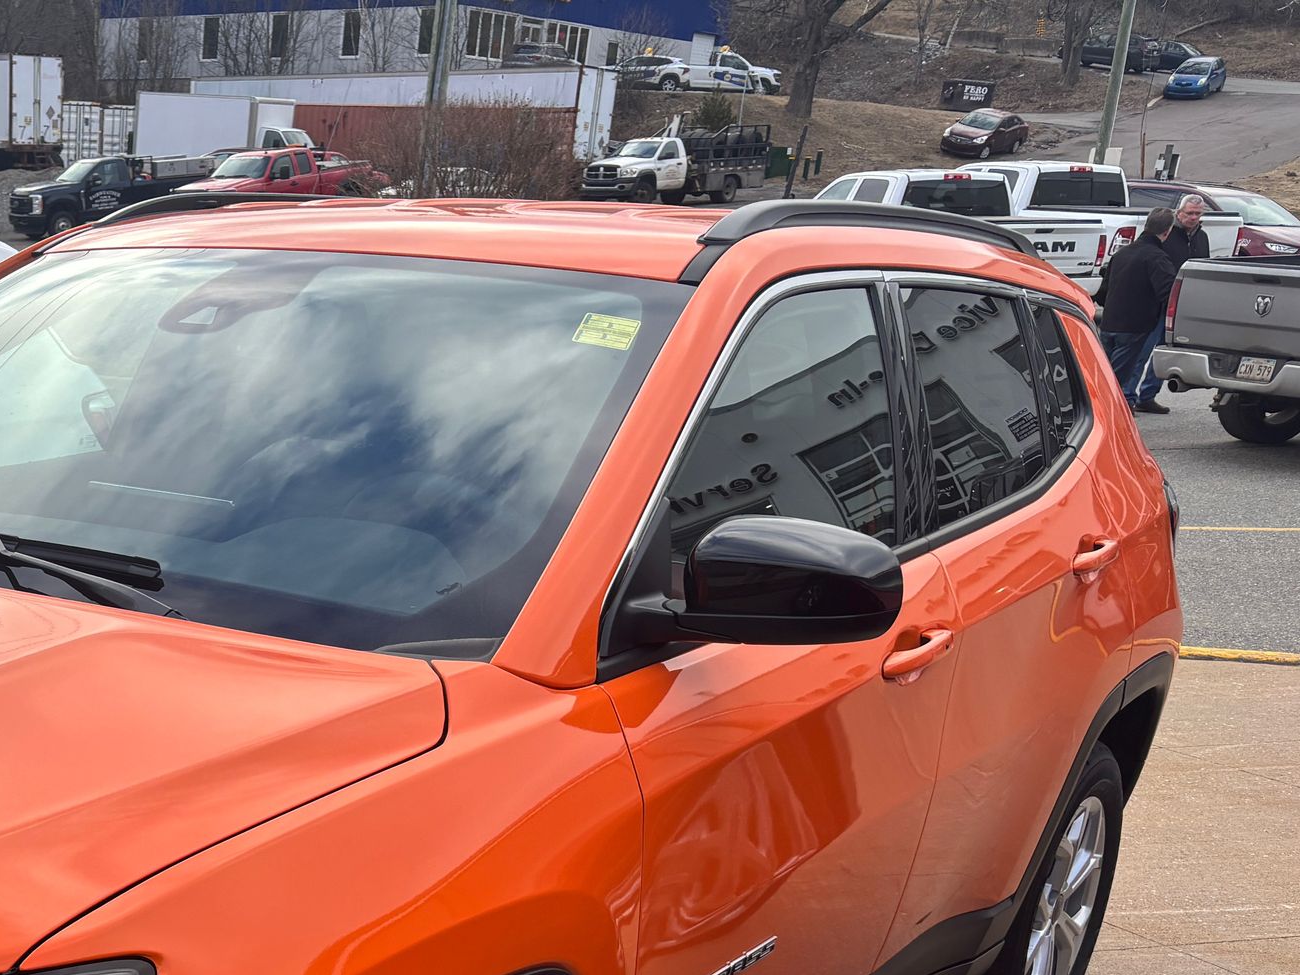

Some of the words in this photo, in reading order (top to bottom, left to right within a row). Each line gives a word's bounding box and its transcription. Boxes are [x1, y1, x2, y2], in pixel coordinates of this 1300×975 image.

[963, 85, 988, 95] FERO
[1033, 241, 1076, 253] AM
[1238, 363, 1255, 375] CXN
[1256, 365, 1272, 377] 579
